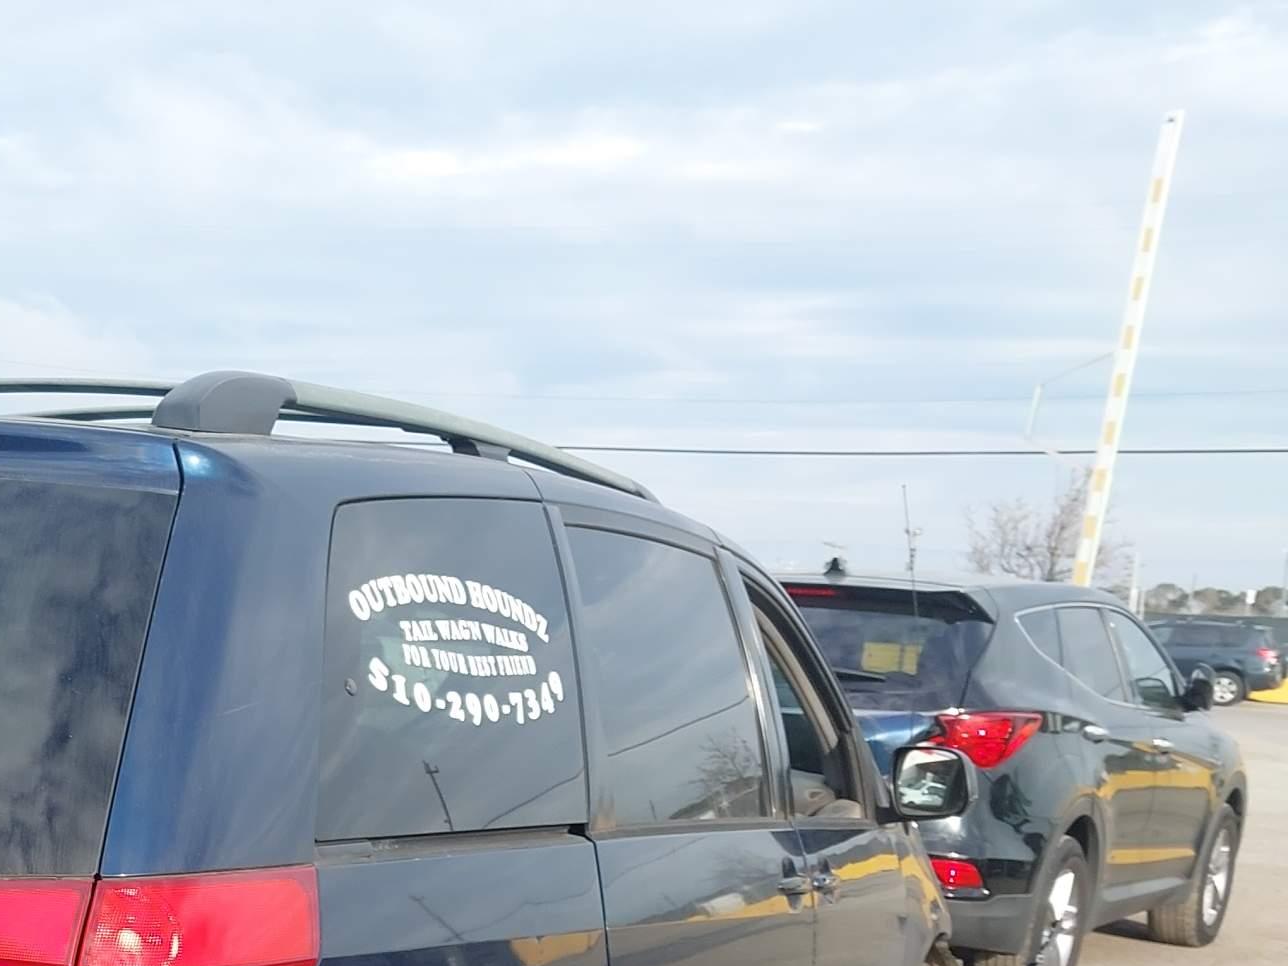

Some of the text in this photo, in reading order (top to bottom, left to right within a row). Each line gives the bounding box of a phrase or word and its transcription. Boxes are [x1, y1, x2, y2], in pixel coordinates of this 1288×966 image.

[348, 573, 550, 643] OUTBOUND HOUNDZ
[399, 620, 439, 641] TAIL
[480, 623, 529, 652] WALKS
[402, 643, 537, 677] FOR YOUR BEST FRIEND
[368, 657, 564, 726] 510-290-7349
